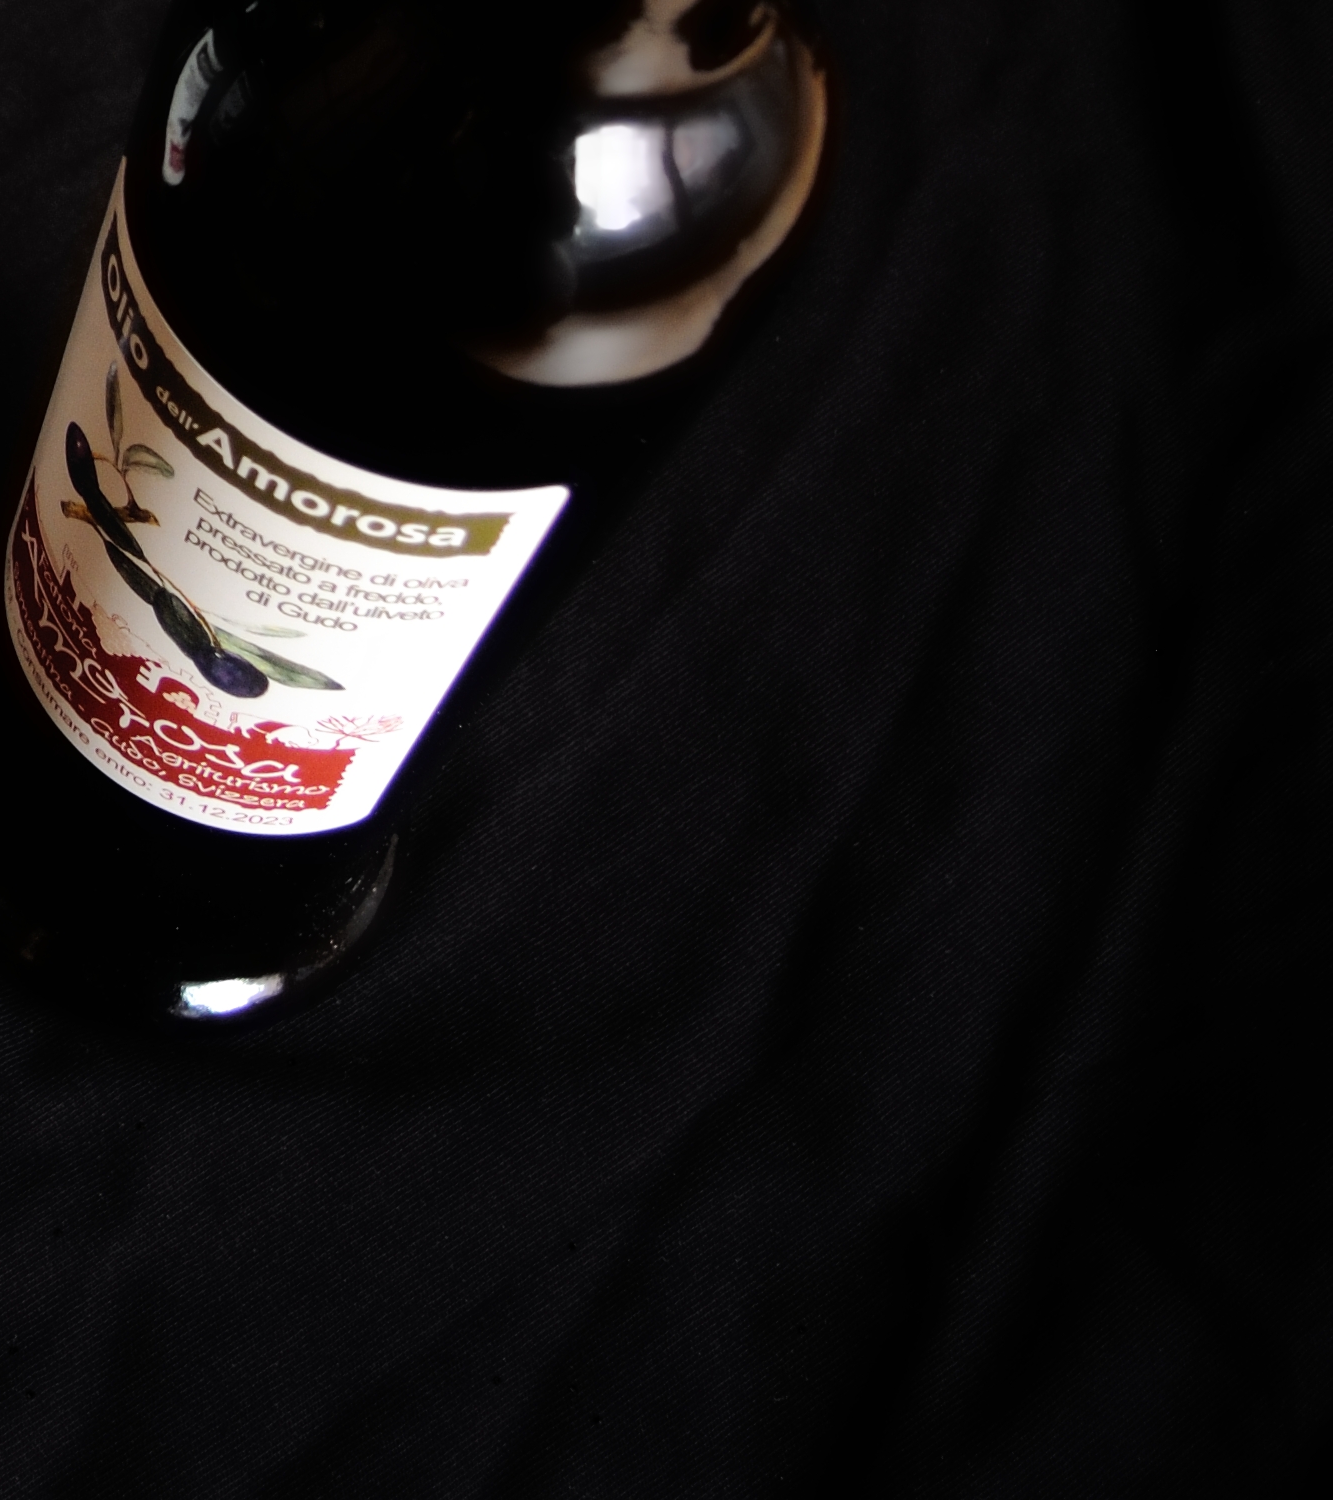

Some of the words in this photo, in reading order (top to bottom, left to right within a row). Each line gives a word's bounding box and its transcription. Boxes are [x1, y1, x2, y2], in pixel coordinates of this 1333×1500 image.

[107, 253, 149, 370] Olio
[183, 529, 291, 597] prodotto
[296, 590, 445, 622] dall'uliveto
[192, 487, 363, 582] Extravergine
[369, 573, 396, 588] di
[402, 577, 469, 590] oliva
[195, 516, 312, 586] pressato
[318, 580, 337, 594] a
[345, 583, 443, 606] freddo,
[245, 588, 272, 608] di
[277, 600, 359, 633] Gudo
[15, 628, 90, 746] Consumare
[94, 746, 154, 791] entro:
[158, 787, 295, 827] 31.12.2023
[130, 734, 331, 796] Agriturismo
